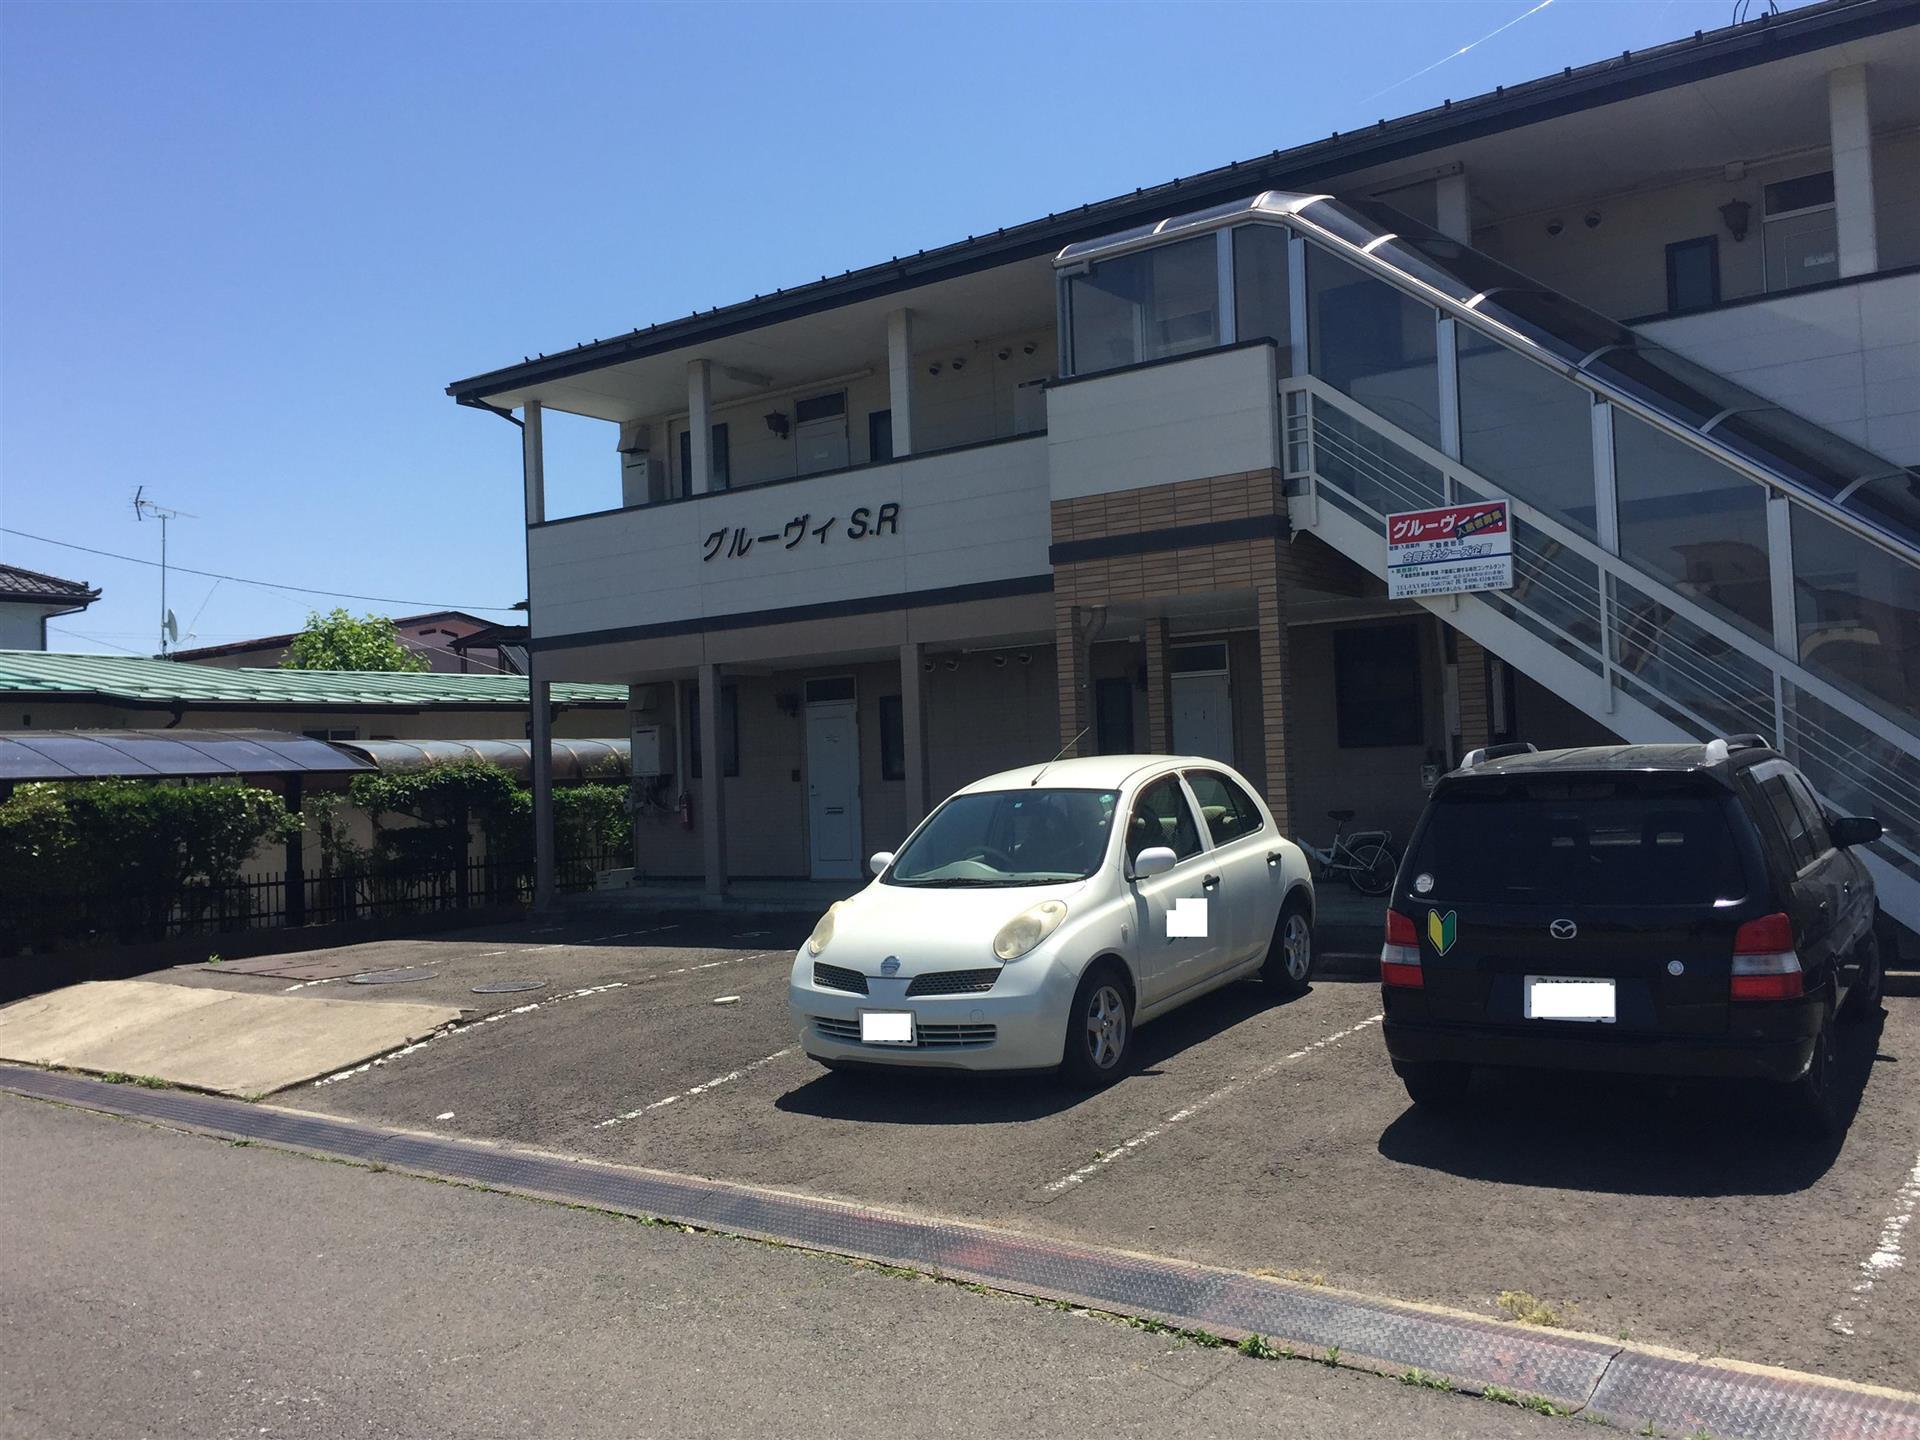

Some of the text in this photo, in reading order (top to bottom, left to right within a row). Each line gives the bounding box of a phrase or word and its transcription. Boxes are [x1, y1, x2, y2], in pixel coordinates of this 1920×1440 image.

[703, 502, 901, 562] グルーヴィ S.R
